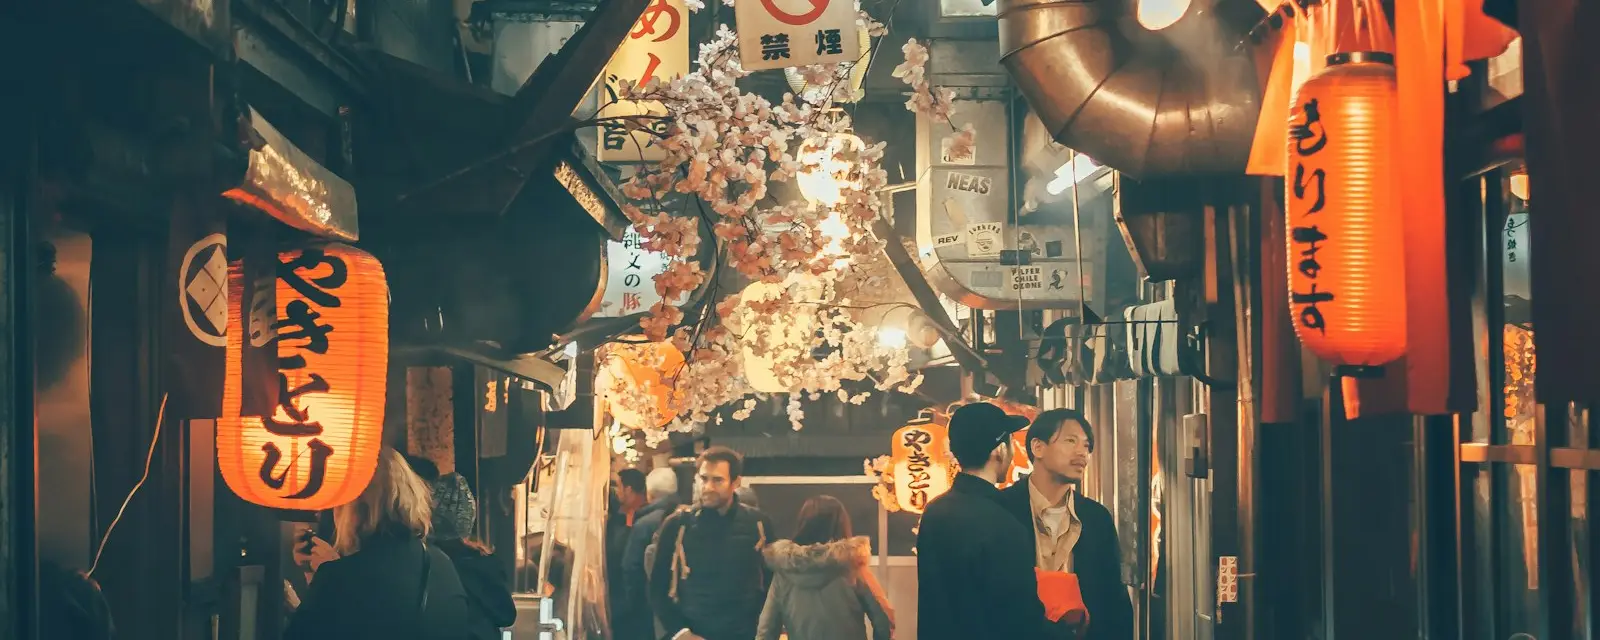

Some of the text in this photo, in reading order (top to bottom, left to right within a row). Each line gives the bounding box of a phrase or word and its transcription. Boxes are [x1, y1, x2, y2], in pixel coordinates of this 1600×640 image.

[760, 29, 843, 61] 禁煙
[947, 172, 991, 195] NEAS
[937, 235, 959, 245] REV
[260, 249, 349, 499] やきとり
[903, 429, 932, 510] やきとり
